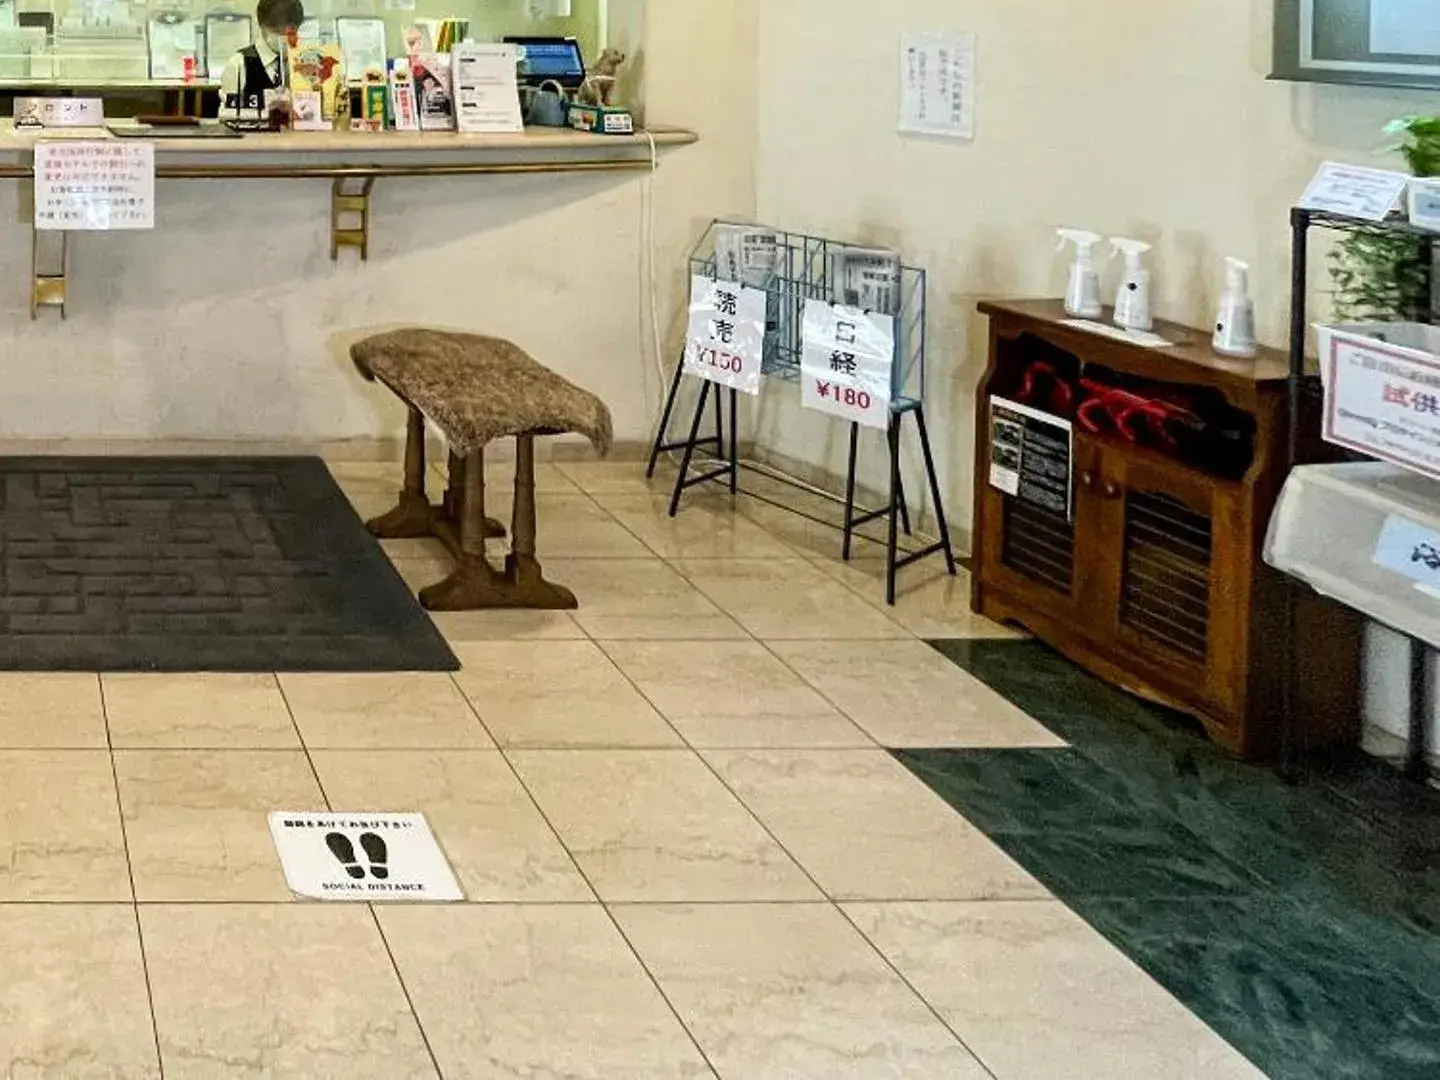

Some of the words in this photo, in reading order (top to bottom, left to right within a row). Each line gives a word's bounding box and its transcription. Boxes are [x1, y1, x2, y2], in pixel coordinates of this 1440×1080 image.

[815, 379, 871, 410] ¥180
[322, 882, 364, 891] SOCIAL
[368, 883, 426, 892] DISTANCE
